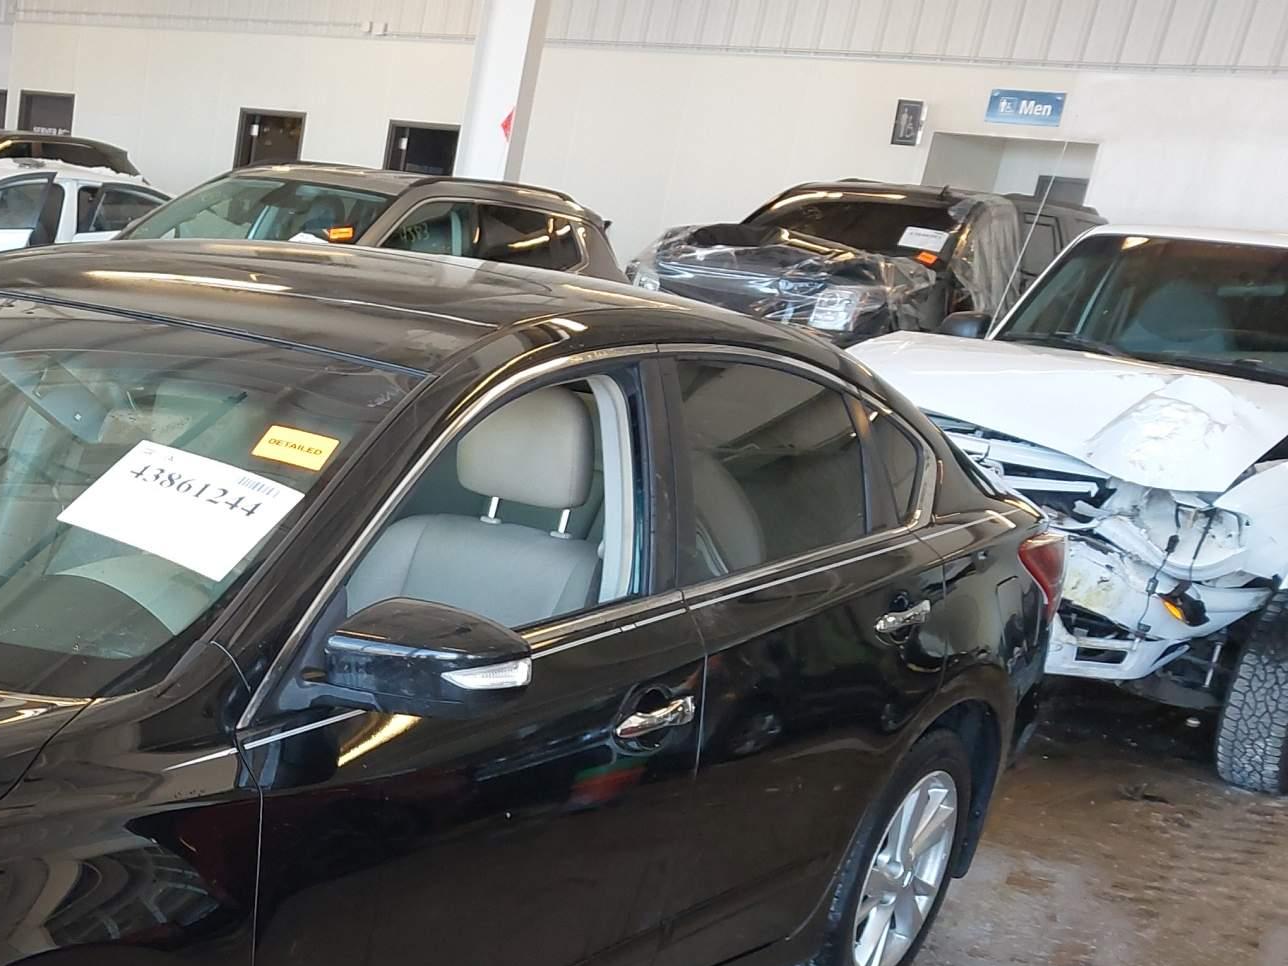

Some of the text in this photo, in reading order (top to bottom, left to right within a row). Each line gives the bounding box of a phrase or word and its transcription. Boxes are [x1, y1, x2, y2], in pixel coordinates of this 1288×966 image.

[1019, 99, 1052, 116] Men
[267, 437, 323, 456] DETAILED
[129, 464, 262, 517] 43861244
